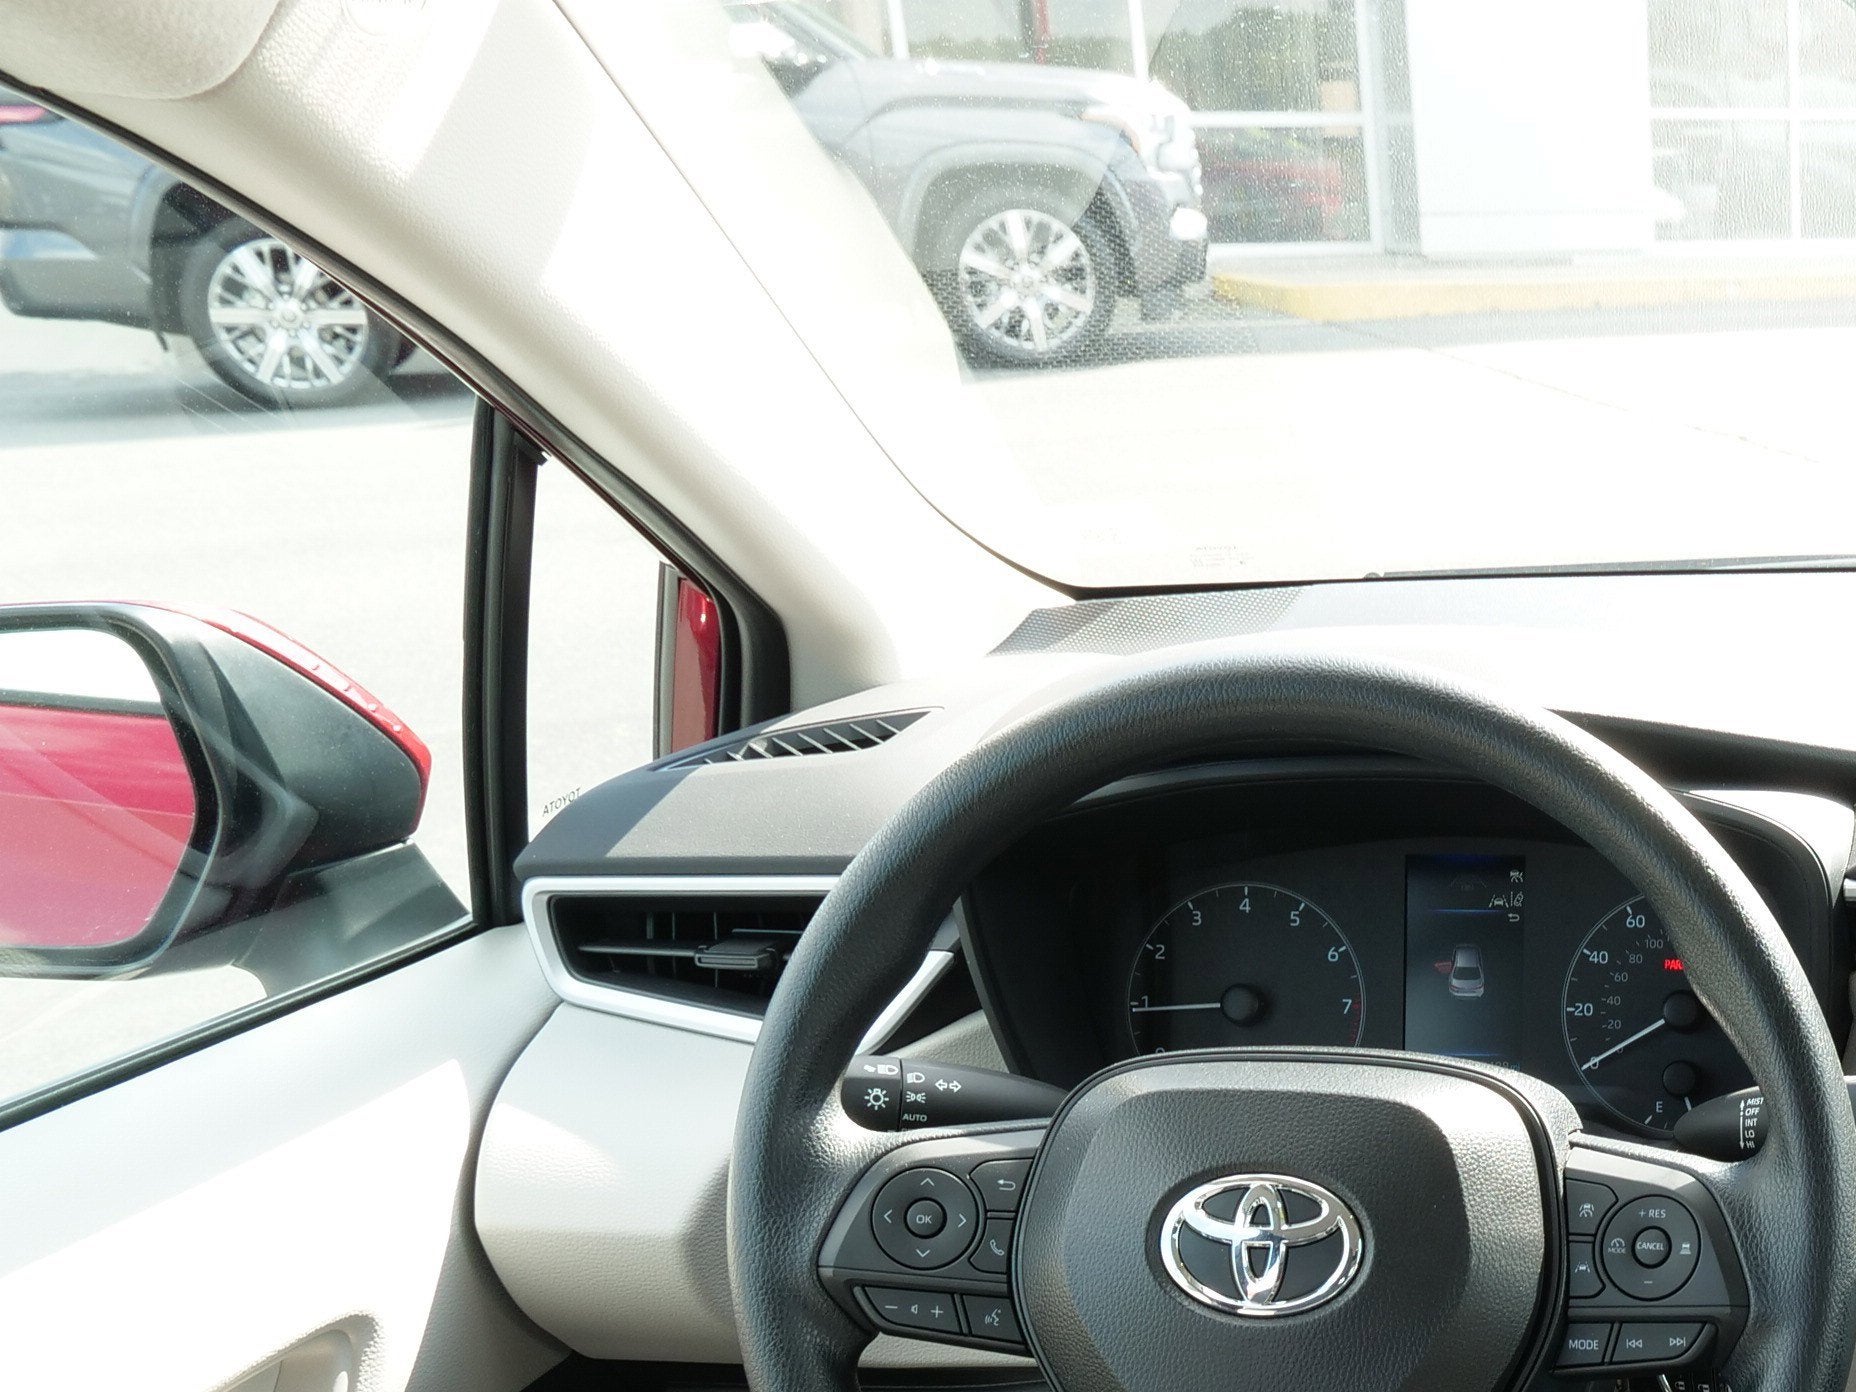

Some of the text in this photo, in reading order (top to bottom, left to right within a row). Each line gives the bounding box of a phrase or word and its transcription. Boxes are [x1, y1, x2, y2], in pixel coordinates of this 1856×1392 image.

[1238, 898, 1251, 914] 4
[1192, 911, 1202, 926] 3
[1290, 911, 1300, 926] 5
[1626, 914, 1646, 928] 60
[1645, 939, 1664, 948] 100
[1154, 944, 1166, 960] 2
[1328, 946, 1339, 962] 6
[1589, 951, 1608, 964] 40
[1629, 954, 1643, 964] 80
[1664, 958, 1684, 970] PAR
[1614, 972, 1628, 982] 60
[1606, 996, 1621, 1006] 40
[1342, 999, 1352, 1014] 7
[1574, 1003, 1594, 1017] 20
[1608, 1020, 1622, 1030] 20
[1746, 1097, 1764, 1106] MIST
[1656, 1102, 1664, 1113] E
[1745, 1107, 1760, 1116] OFF
[902, 1113, 928, 1122] AUTO
[1745, 1118, 1758, 1127] INT
[1744, 1130, 1755, 1138] LO
[1746, 1140, 1755, 1148] HI
[1648, 1208, 1666, 1218] RES
[916, 1214, 932, 1224] OK
[1636, 1241, 1664, 1251] CANCEL
[1568, 1339, 1599, 1350] MODE
